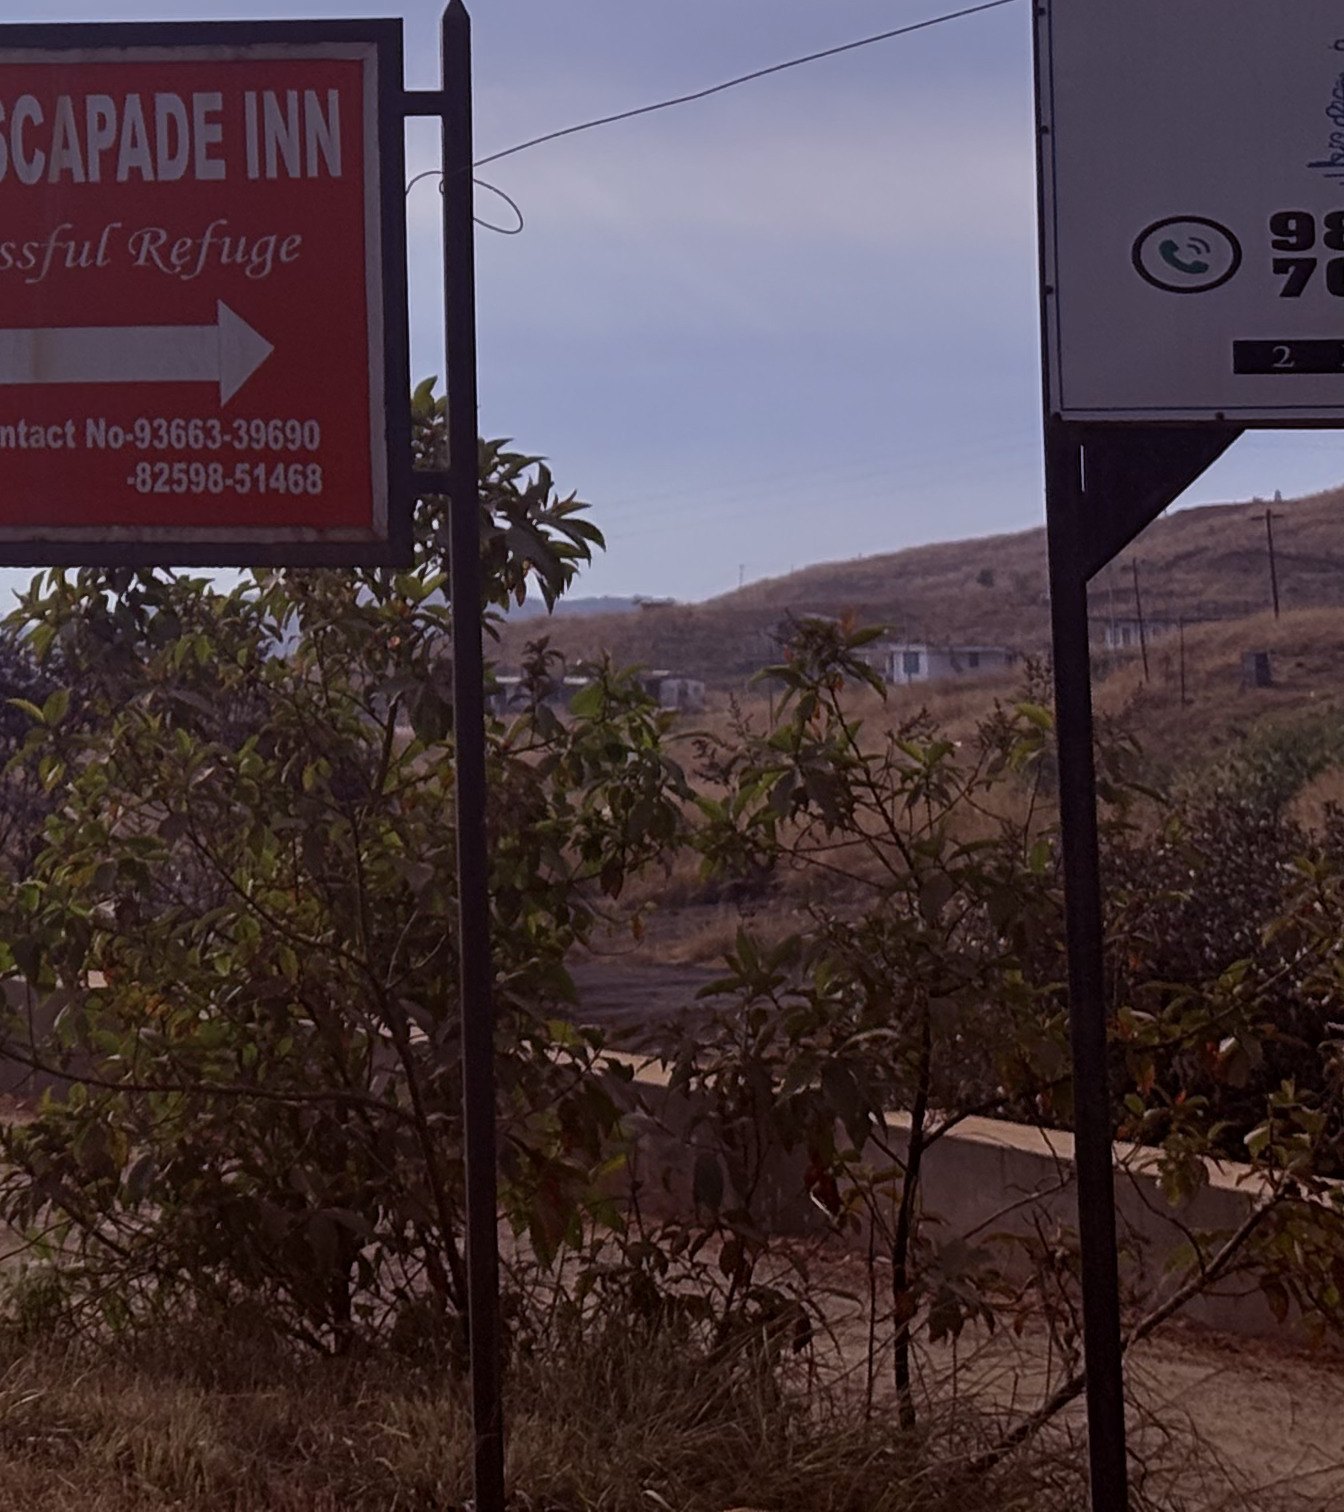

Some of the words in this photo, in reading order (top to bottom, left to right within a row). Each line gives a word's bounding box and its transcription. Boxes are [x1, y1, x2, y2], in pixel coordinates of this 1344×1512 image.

[244, 89, 342, 179] INN
[127, 219, 303, 281] Refuge
[1271, 346, 1295, 368] 2
